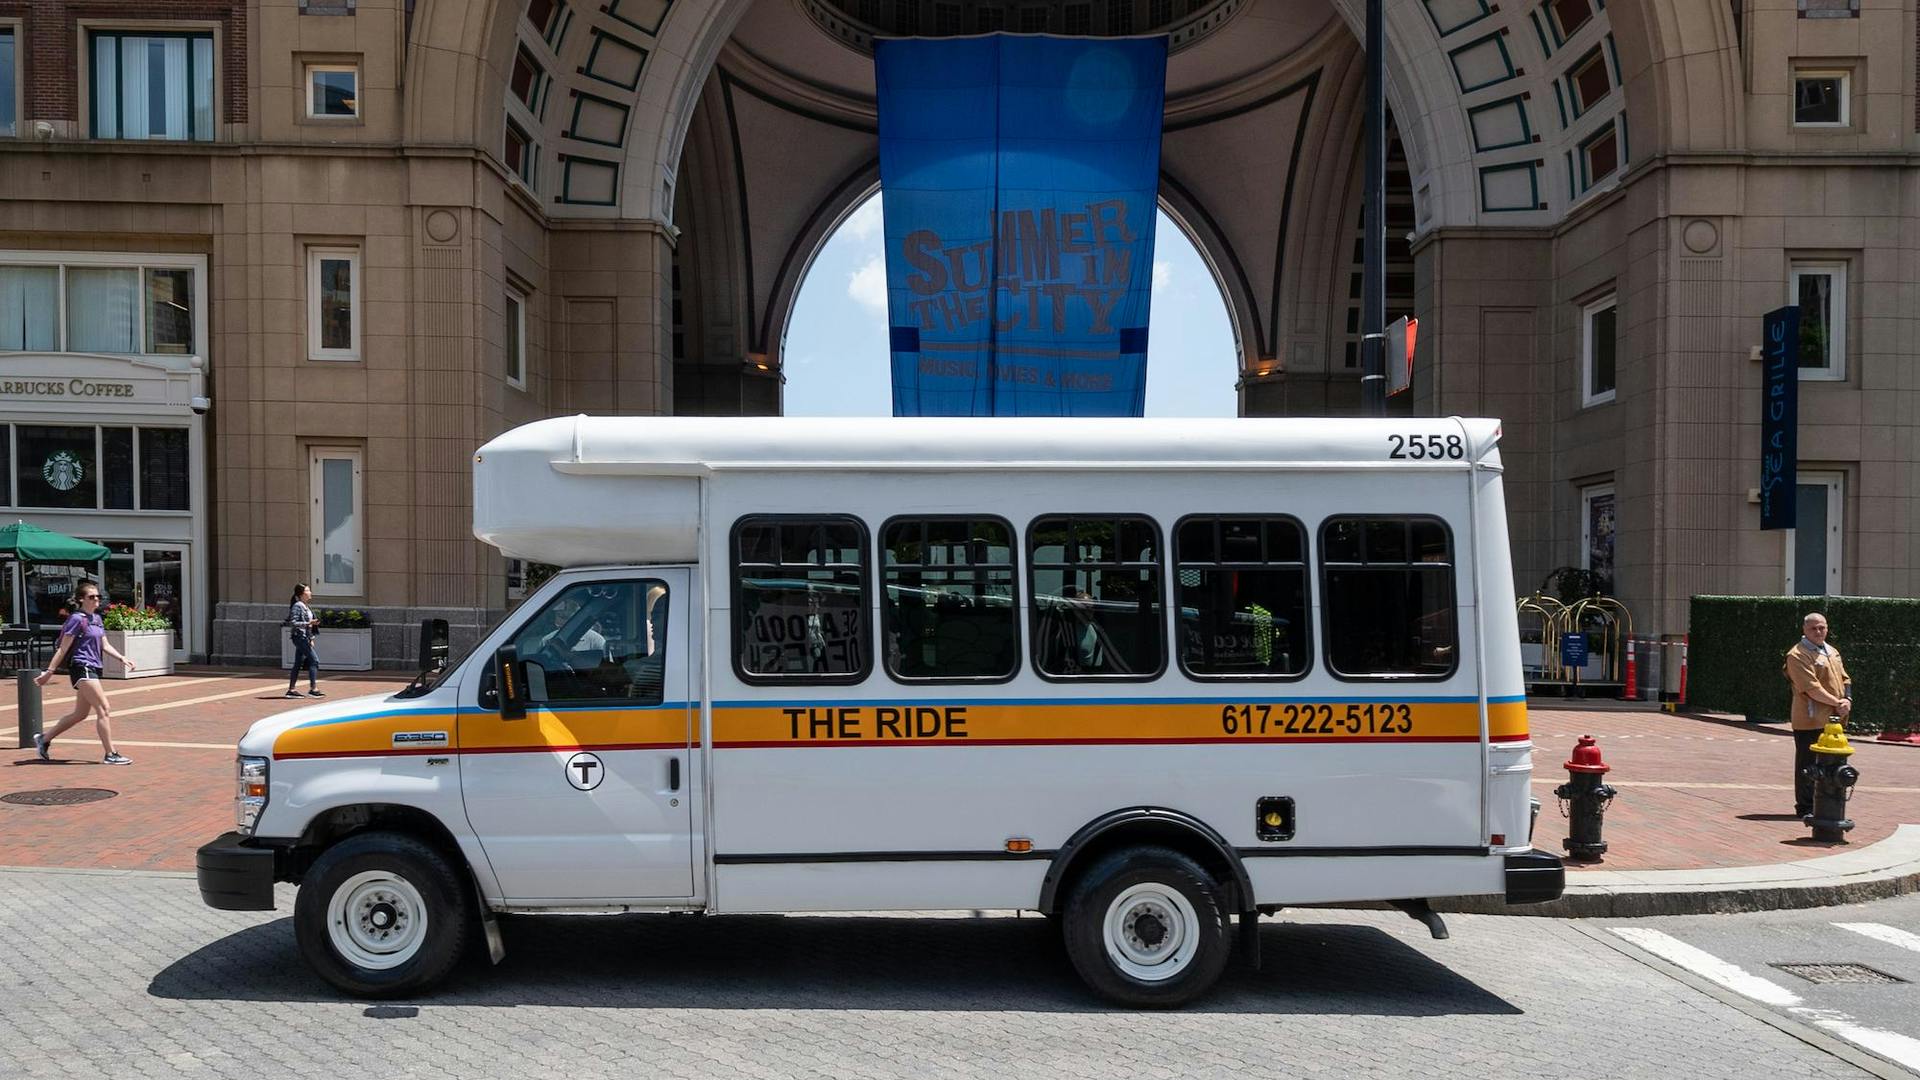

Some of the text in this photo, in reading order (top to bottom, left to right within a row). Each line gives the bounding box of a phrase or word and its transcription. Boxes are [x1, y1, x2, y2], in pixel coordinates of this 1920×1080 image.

[1082, 249, 1131, 285] IN
[911, 278, 1126, 334] THE CITY
[1771, 320, 1785, 420] GRILLE
[69, 379, 135, 397] COFFEE
[1388, 434, 1464, 460] 2558
[1762, 431, 1783, 490] SEA
[48, 583, 72, 595] DRAFT
[783, 707, 968, 739] THE RIDE
[1222, 704, 1413, 734] 617-222-5123
[572, 762, 597, 784] T
